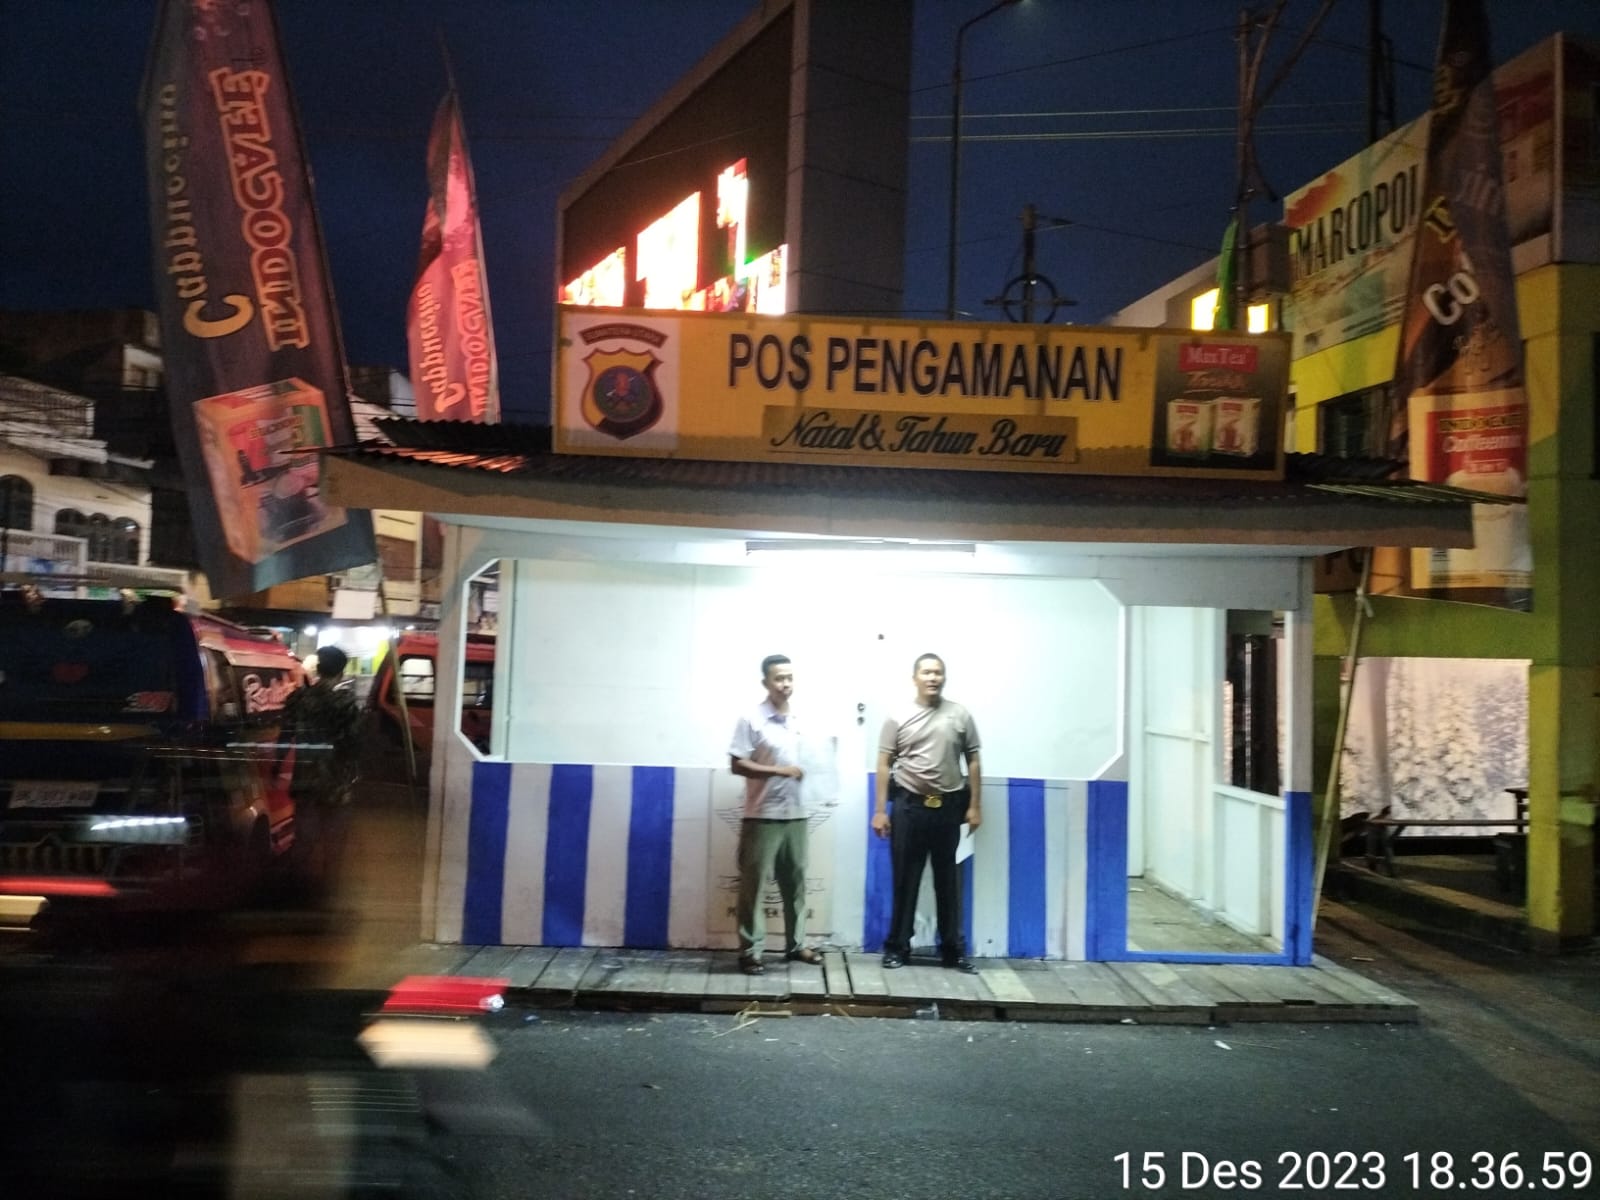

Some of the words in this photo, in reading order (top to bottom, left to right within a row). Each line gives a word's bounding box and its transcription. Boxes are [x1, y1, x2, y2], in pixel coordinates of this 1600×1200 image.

[1423, 270, 1480, 325] Co
[729, 332, 812, 391] POS
[826, 336, 1123, 401] PENGAMANAN
[769, 411, 864, 448] Natal
[887, 415, 978, 455] Tahun
[978, 417, 1069, 458] Baru
